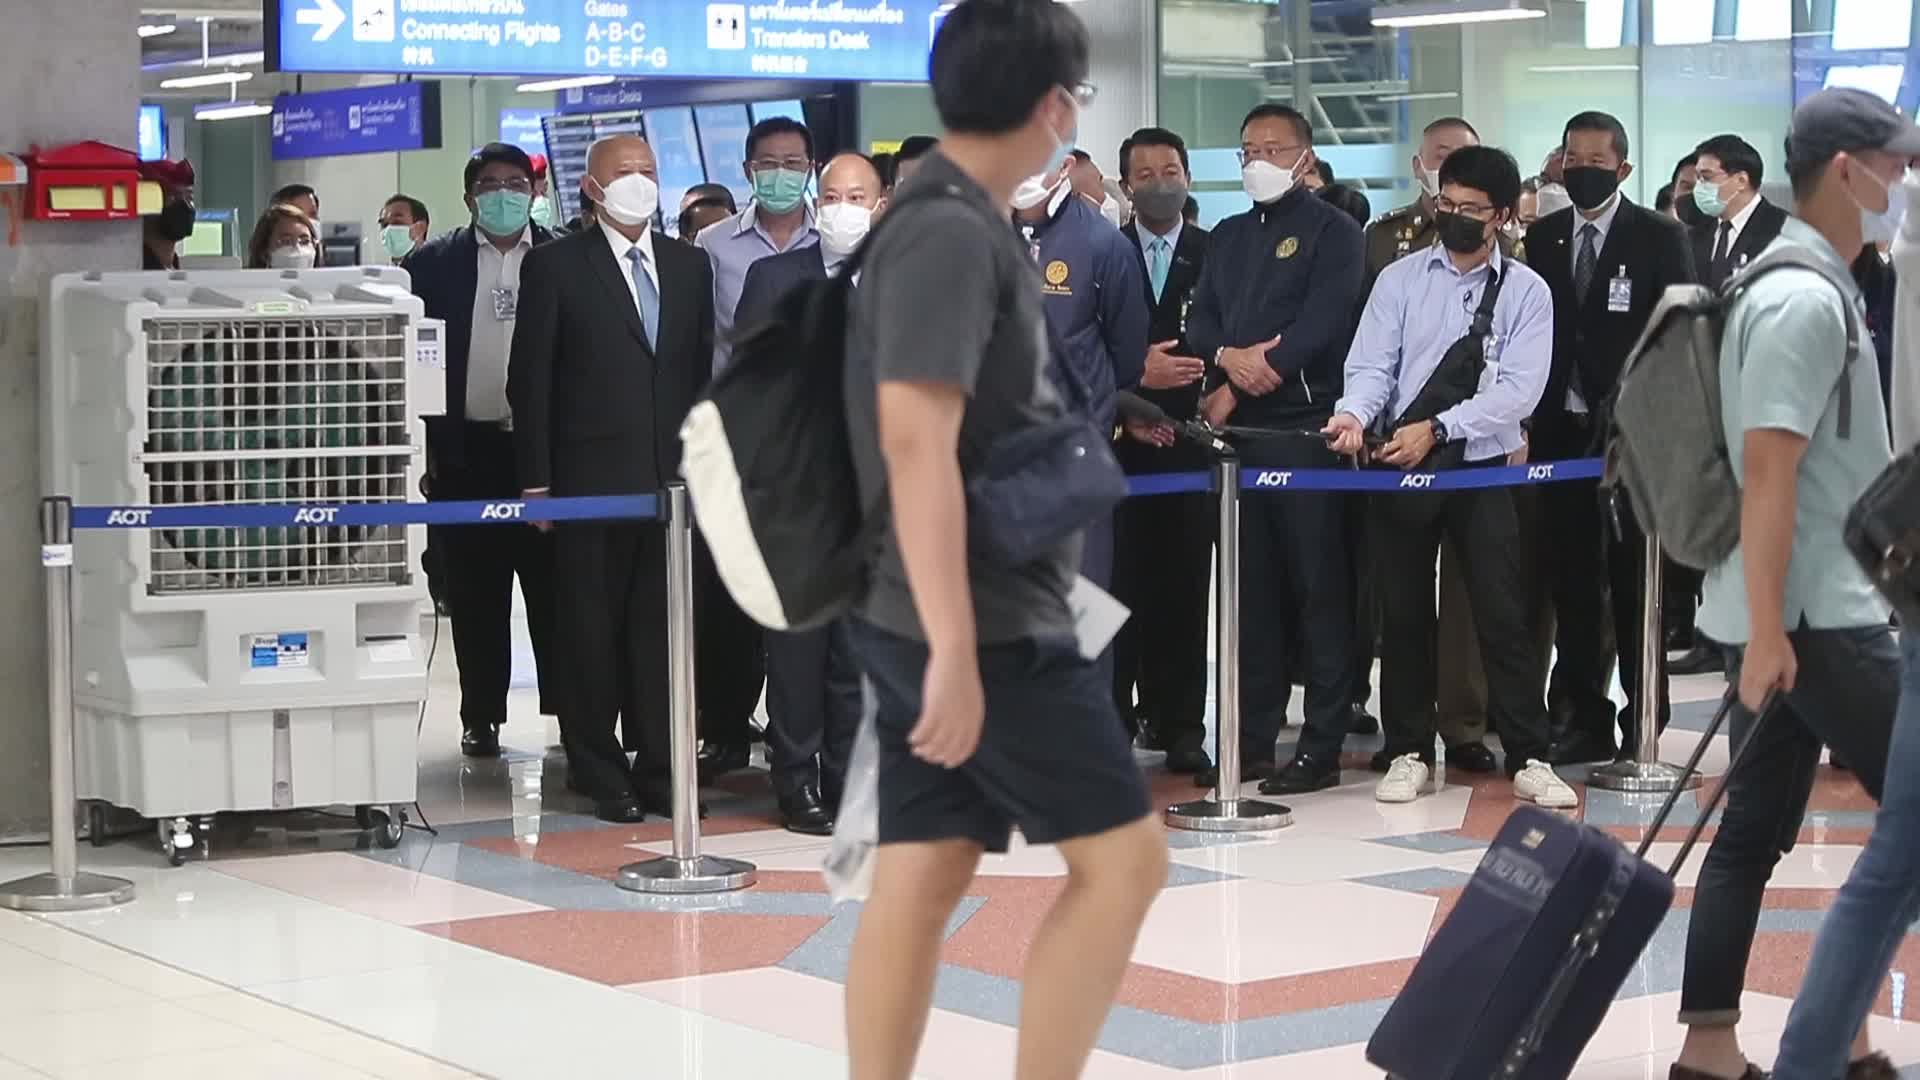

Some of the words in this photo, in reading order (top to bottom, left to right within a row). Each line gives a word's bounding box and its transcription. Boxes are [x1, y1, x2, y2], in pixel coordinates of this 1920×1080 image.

[585, 0, 627, 17] Gates
[402, 18, 500, 46] Connecting
[504, 20, 561, 47] Flights
[585, 22, 645, 43] A-B-C
[751, 27, 827, 49] Transfers
[829, 29, 870, 50] Desk
[585, 46, 668, 68] D-E-F-G
[1256, 472, 1292, 486] AOT
[1527, 464, 1554, 480] AOT
[1400, 473, 1436, 488] AOT
[107, 509, 153, 525] AOT
[293, 508, 339, 523] AOT
[480, 503, 526, 519] AOT
